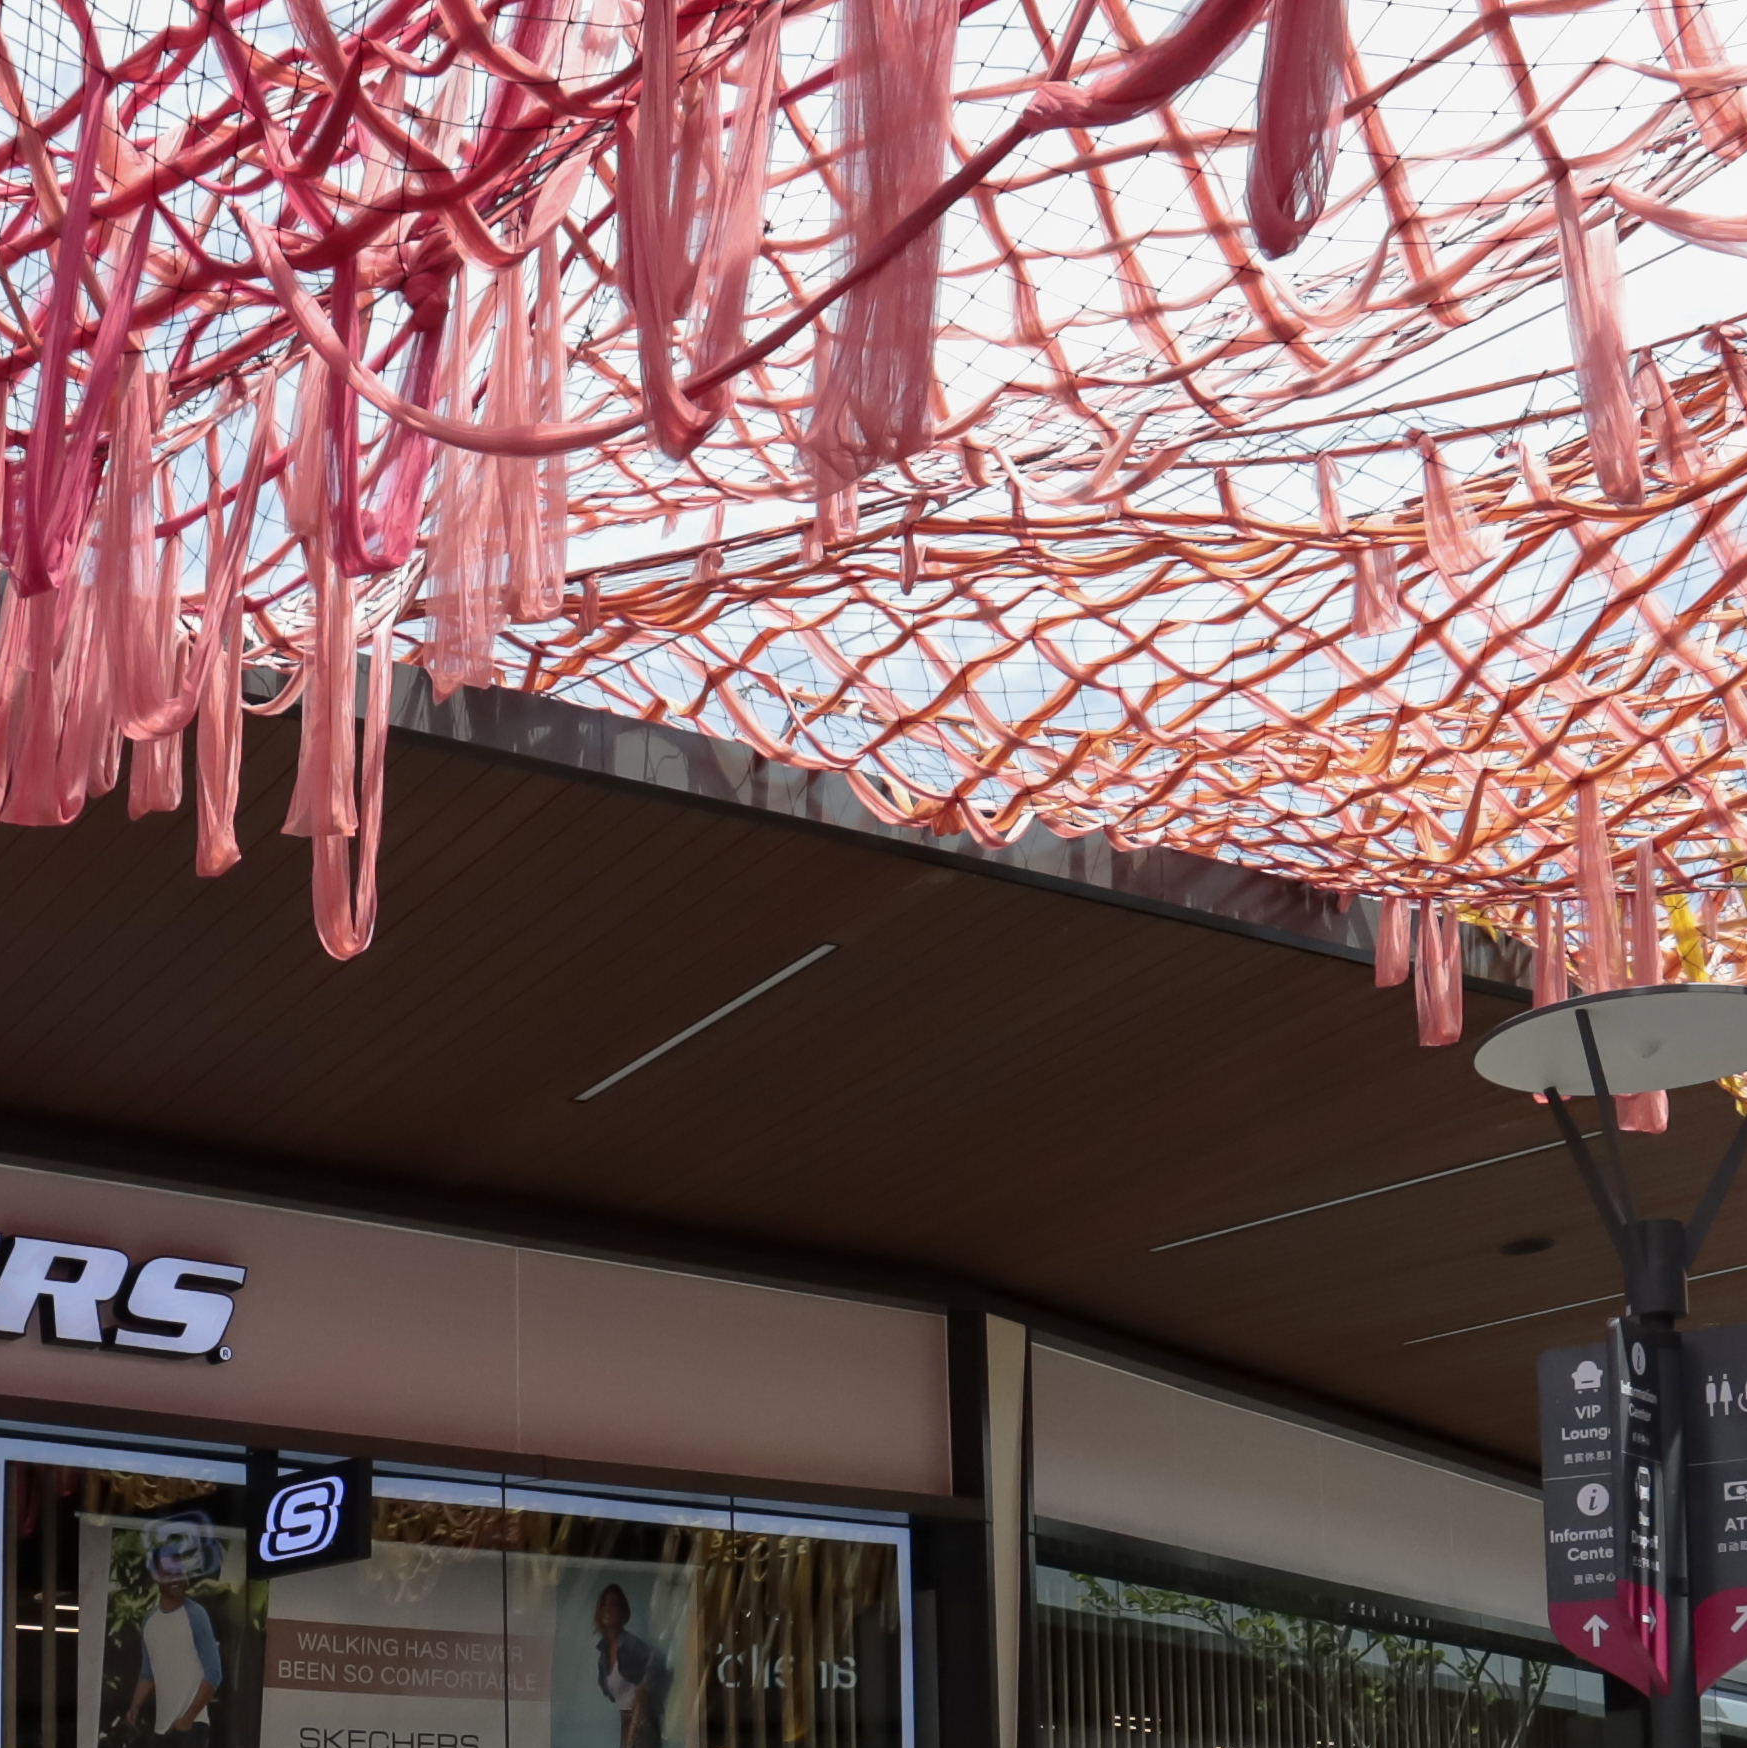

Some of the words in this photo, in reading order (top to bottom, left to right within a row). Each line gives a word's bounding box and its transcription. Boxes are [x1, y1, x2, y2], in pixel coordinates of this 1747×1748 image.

[1575, 1405, 1601, 1420] VIP
[1550, 1526, 1614, 1543] Informat
[1567, 1547, 1614, 1562] Cente
[298, 1631, 398, 1657] WALKING
[405, 1641, 449, 1659] HAS
[455, 1643, 524, 1664] NEVER
[278, 1659, 336, 1682] BEEN
[343, 1665, 374, 1684] SO
